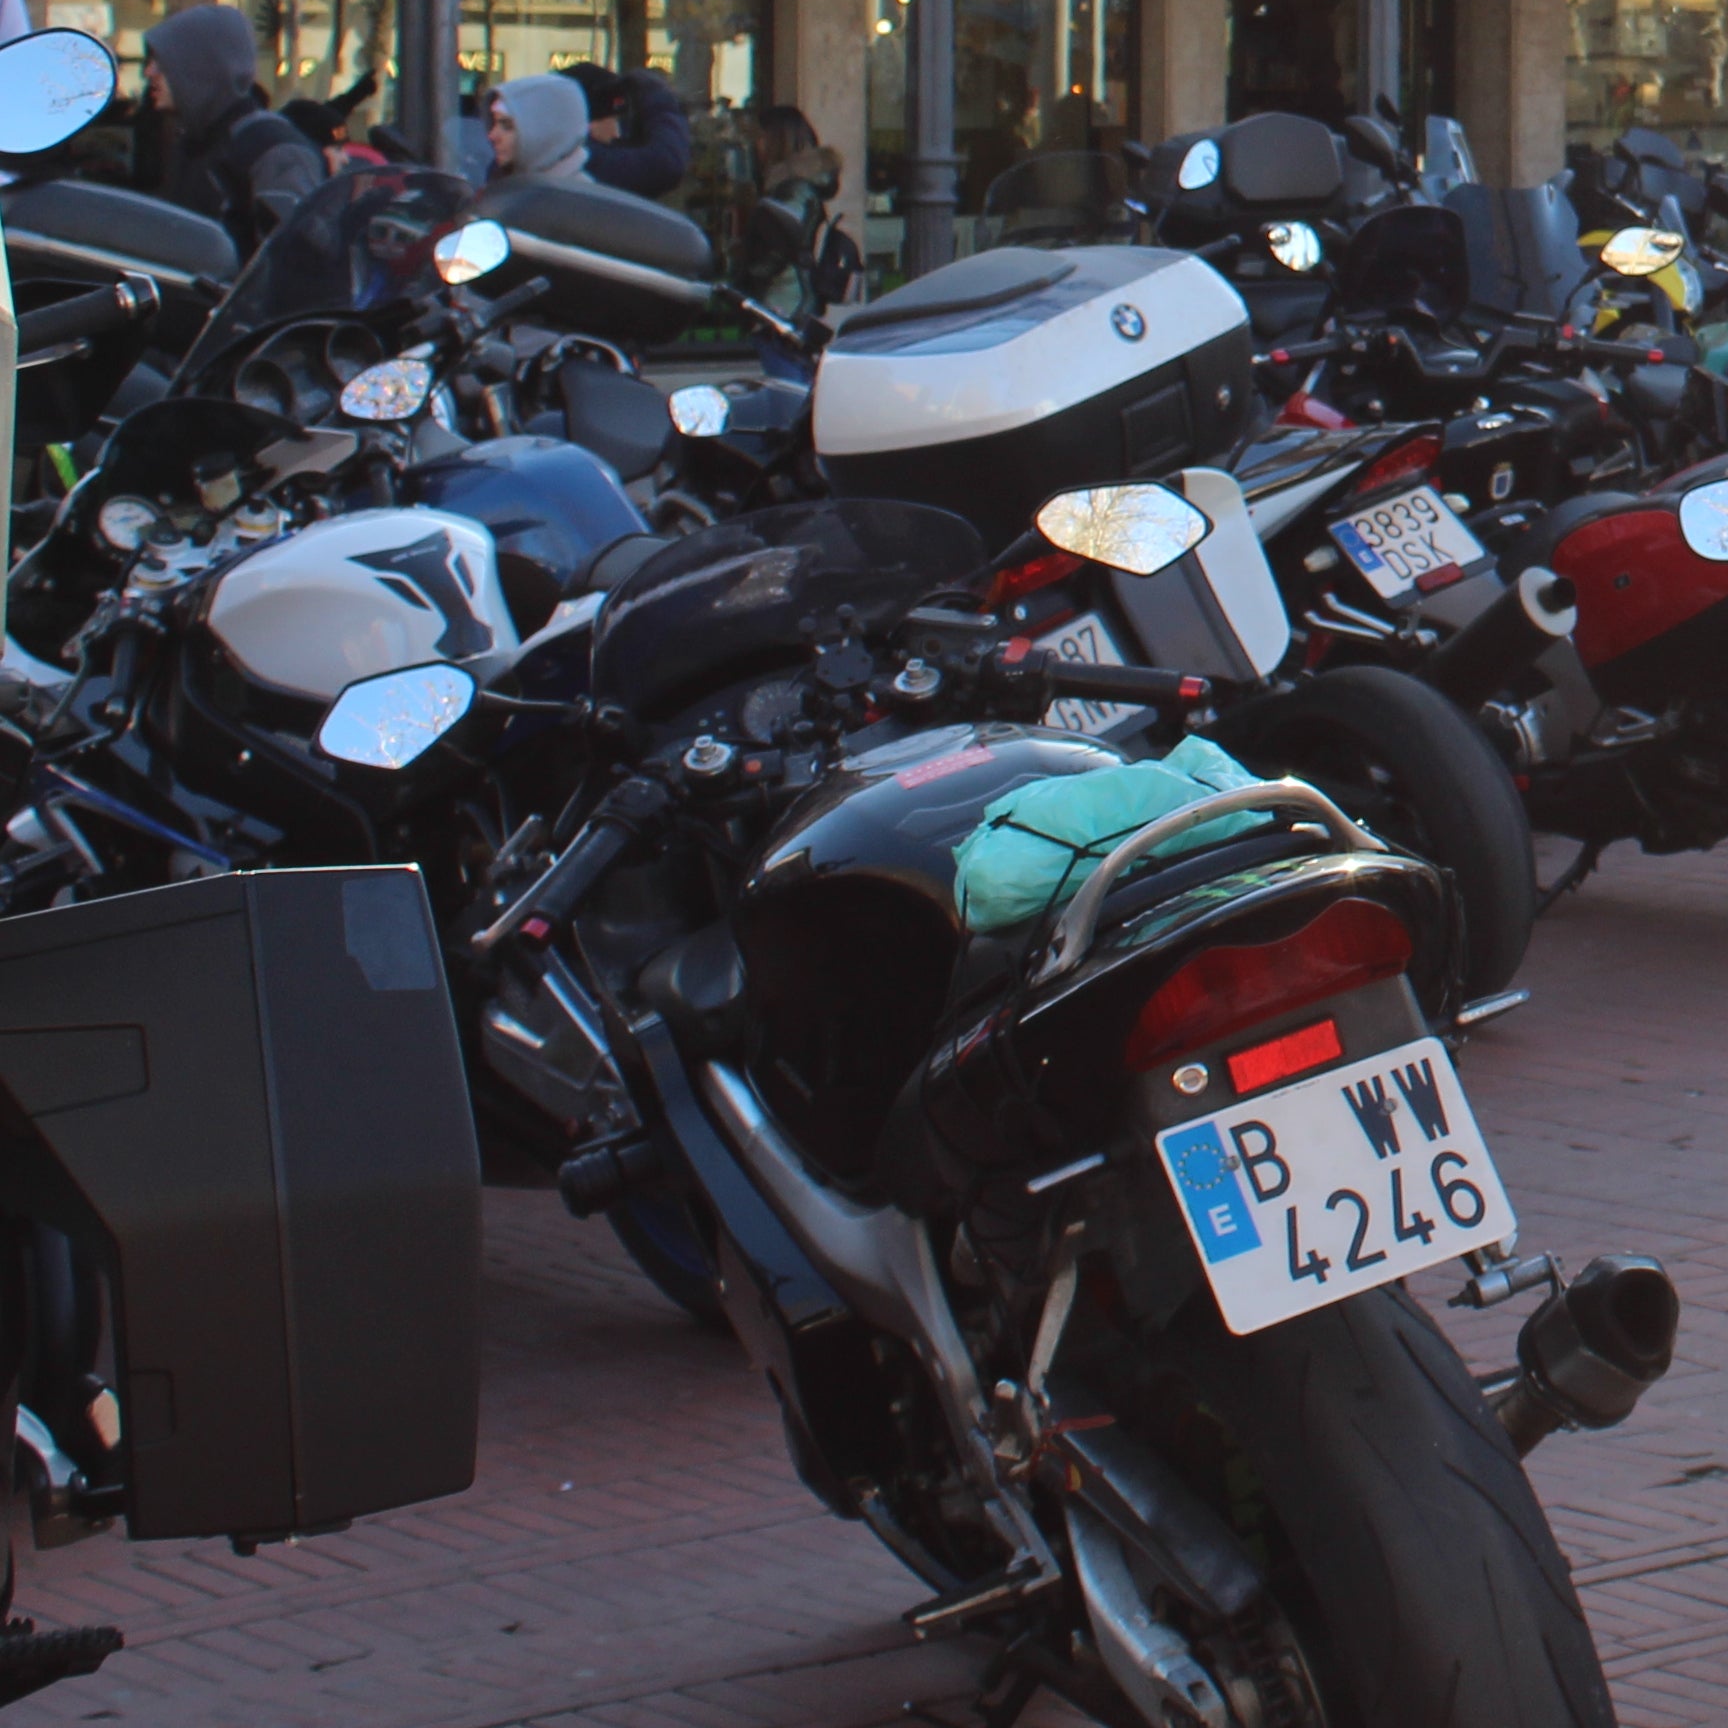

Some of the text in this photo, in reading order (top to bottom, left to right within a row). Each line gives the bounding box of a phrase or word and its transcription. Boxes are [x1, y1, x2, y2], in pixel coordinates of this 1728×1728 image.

[1353, 494, 1440, 548] 3839
[1380, 530, 1454, 580] DSK
[1045, 623, 1100, 665] 87
[1055, 697, 1118, 732] GN
[1229, 1057, 1450, 1204] B WW
[1208, 1202, 1237, 1238] E
[1286, 1151, 1487, 1285] 4246
